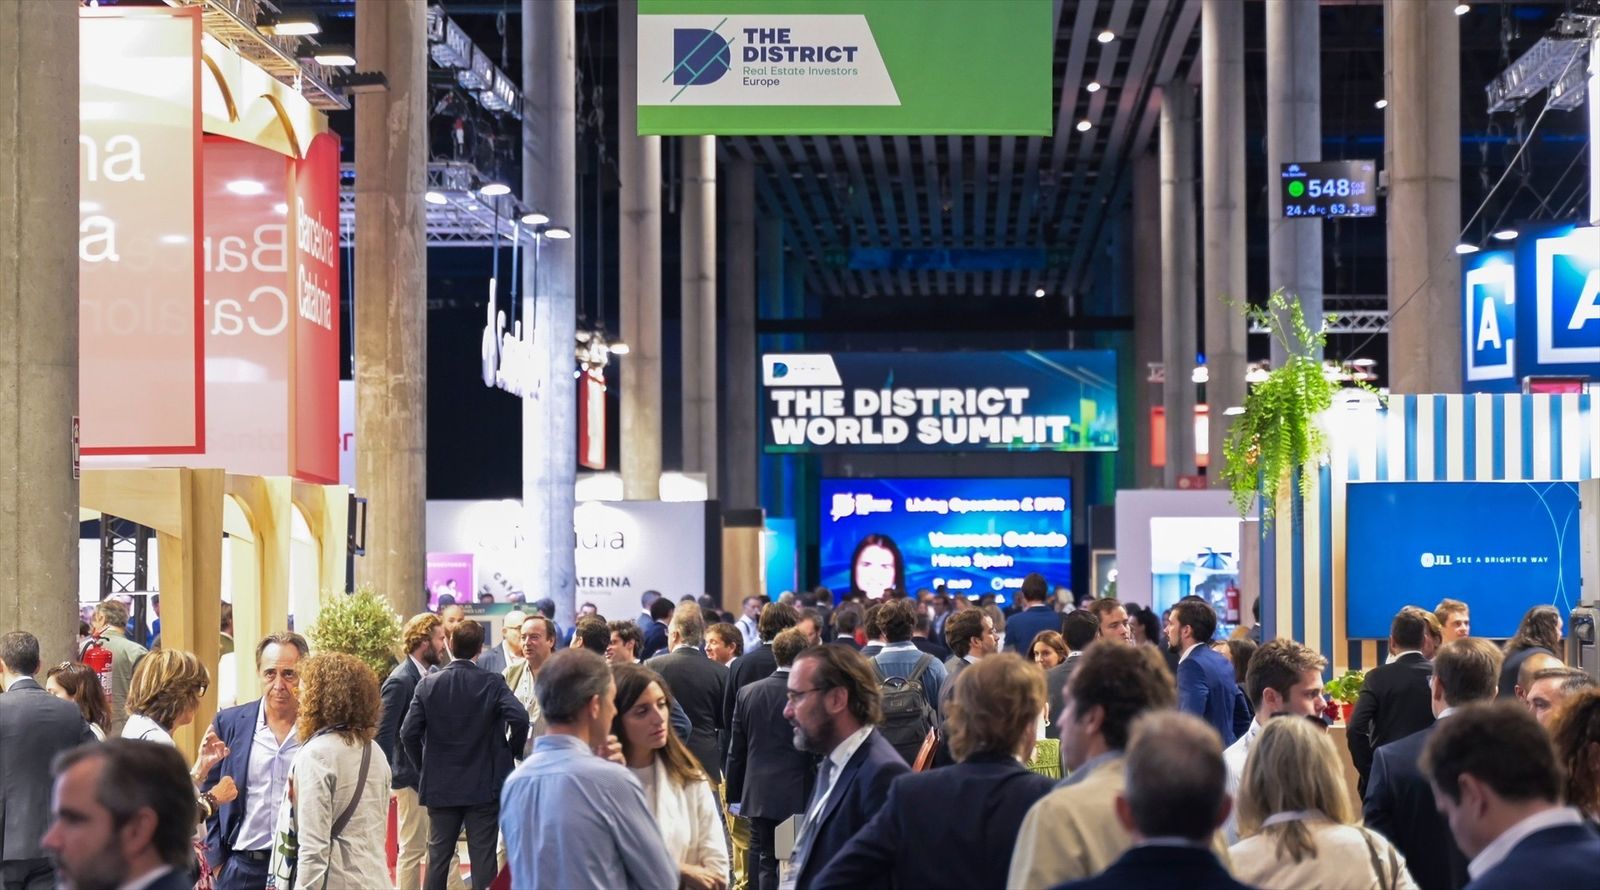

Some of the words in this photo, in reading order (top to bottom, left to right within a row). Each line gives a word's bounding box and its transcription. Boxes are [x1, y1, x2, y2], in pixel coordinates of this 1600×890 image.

[743, 28, 791, 44] THE
[743, 46, 858, 63] DISTRICT
[743, 66, 767, 76] Real
[770, 66, 806, 76] Estate
[808, 66, 859, 76] Investors
[743, 77, 780, 88] Europe
[1308, 179, 1350, 197] 548
[298, 196, 334, 268] Barcelona
[299, 263, 331, 331] Catalonia
[1477, 297, 1502, 351] A
[771, 389, 845, 416] THE
[854, 387, 1030, 417] DISTRICT
[771, 417, 909, 445] WORLD
[917, 416, 1071, 445] SUMMIT
[1434, 555, 1452, 566] JLL
